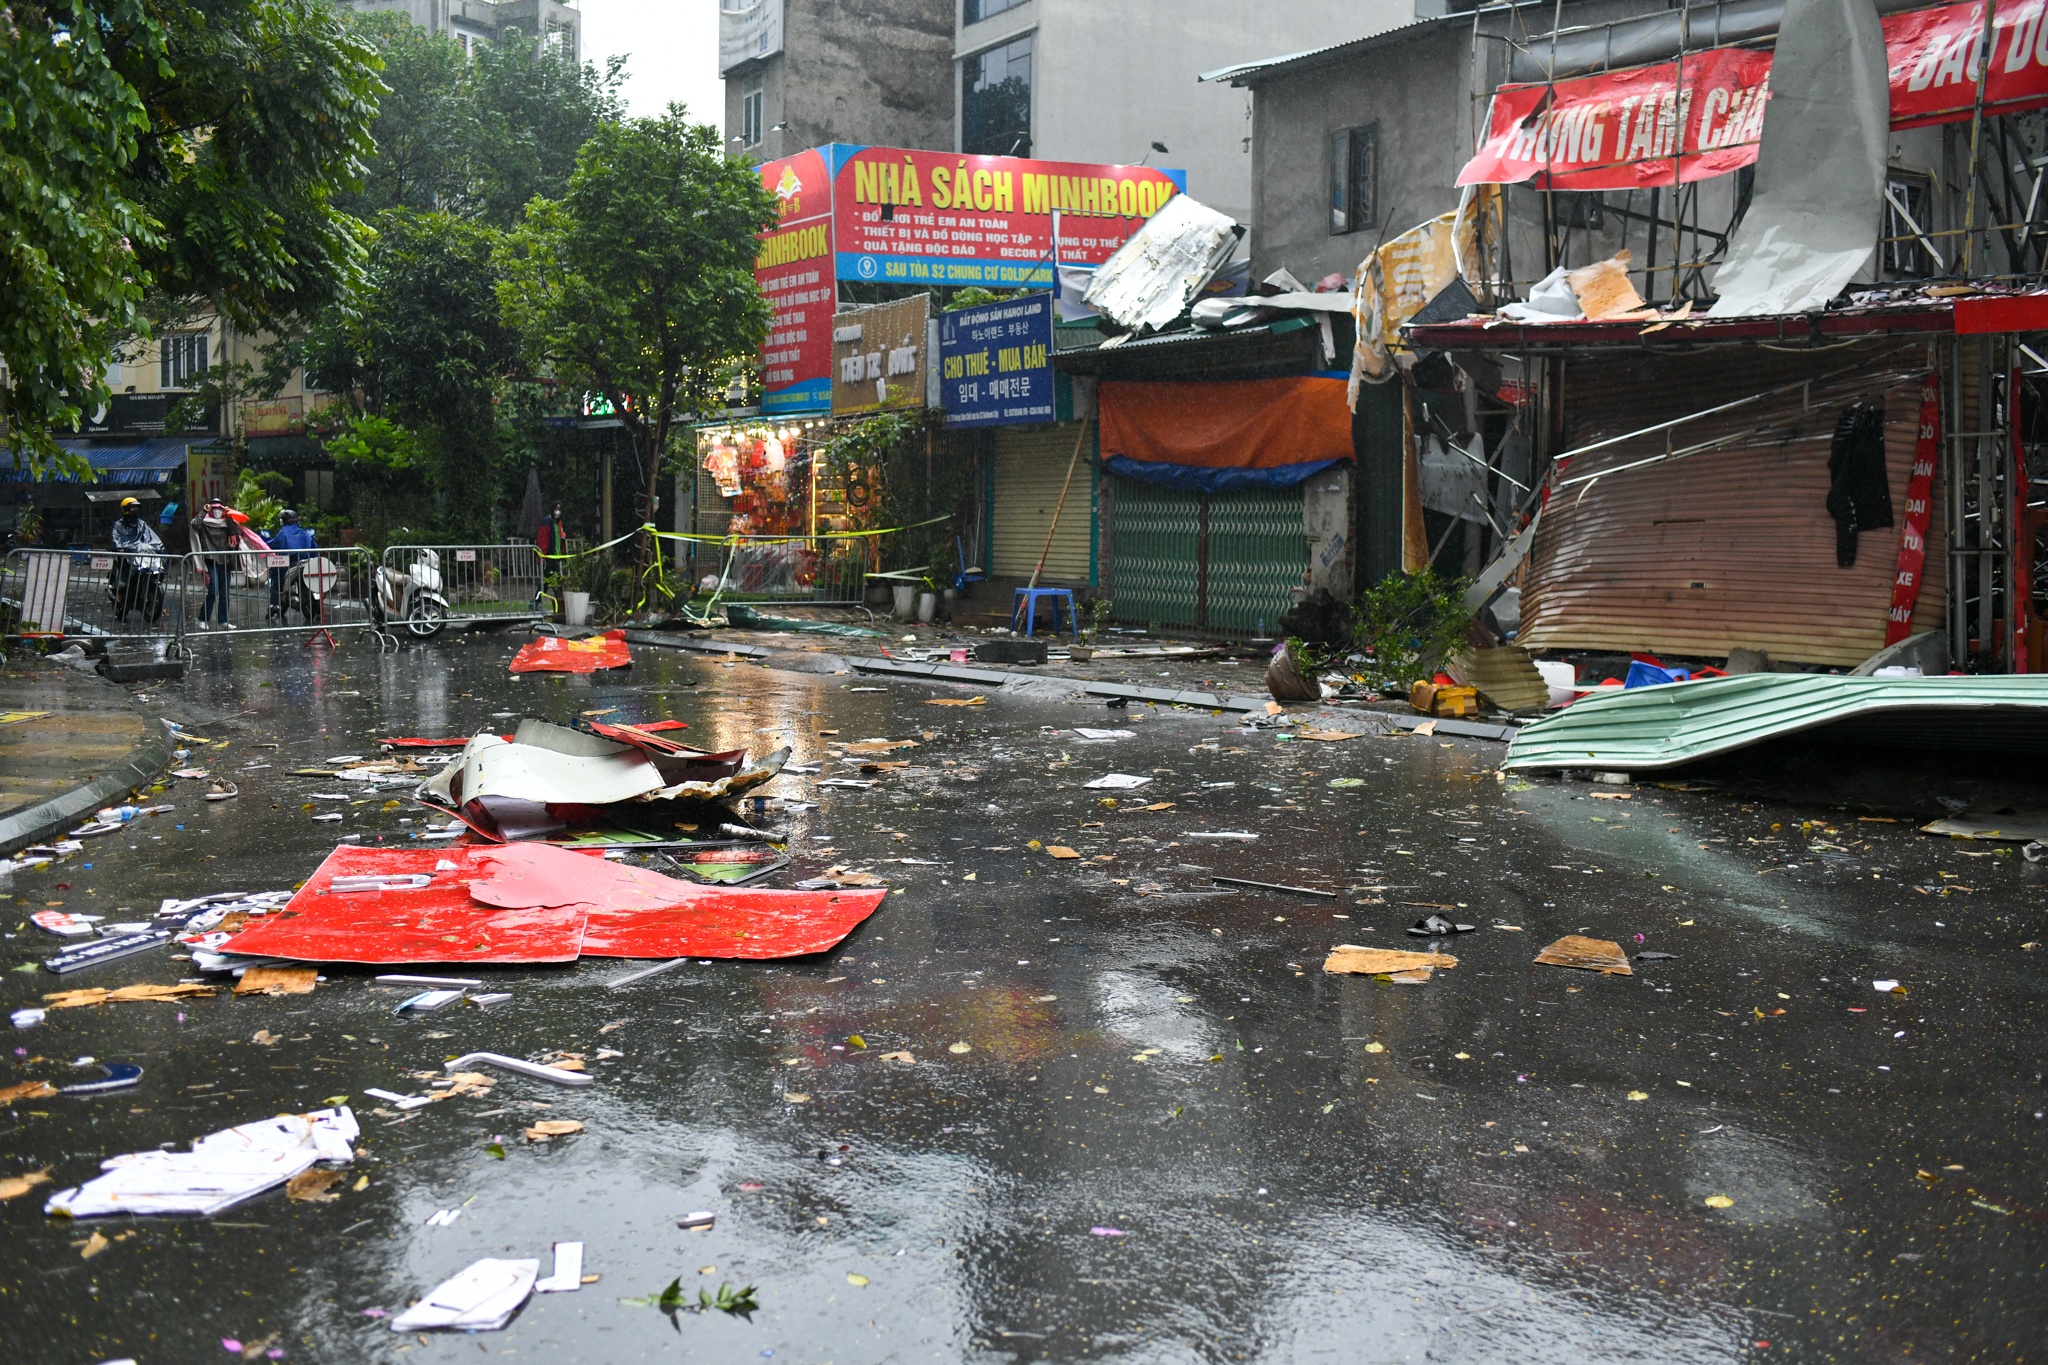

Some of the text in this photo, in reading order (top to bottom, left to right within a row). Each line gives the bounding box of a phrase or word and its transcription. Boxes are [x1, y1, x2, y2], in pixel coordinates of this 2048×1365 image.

[1907, 4, 2000, 92] BẢO
[1495, 101, 1610, 163] TRUNG
[1615, 81, 1693, 160] TÂM
[854, 155, 1174, 220] NHÀ SÁCH MINHBOOK
[883, 213, 910, 224] HƠI
[913, 212, 935, 226] TRẺ
[938, 216, 956, 227] EM
[959, 217, 976, 228] AN
[978, 218, 1008, 230] TOÀN
[863, 224, 895, 238] THIẾT
[899, 228, 911, 240] BỊ
[913, 228, 929, 239] VÀ
[951, 230, 983, 242] DÙNG
[985, 232, 1009, 245] HỌC
[1011, 232, 1032, 246] TẬP
[1082, 238, 1097, 249] CỤ
[863, 240, 888, 252] QUÀ
[891, 241, 922, 254] TẶNG
[925, 243, 949, 256] ĐỘC
[952, 244, 976, 256] ĐÁO
[1000, 247, 1036, 258] DECOR
[1062, 248, 1087, 260] THẤT
[885, 260, 1053, 283] SAU TÒA S2 CHUNG CƯ GOLDMARK
[1003, 306, 1023, 319] HANOI
[1024, 303, 1042, 315] LAND
[1008, 321, 1029, 336] 부동산
[944, 355, 964, 380] CHO
[965, 346, 990, 378] THUÊ
[998, 346, 1022, 373] MUA
[1023, 339, 1047, 370] BÁN
[958, 382, 978, 403] 임대
[989, 377, 1031, 400] 매매전문
[1904, 536, 1918, 550] TU
[1896, 572, 1914, 587] XE
